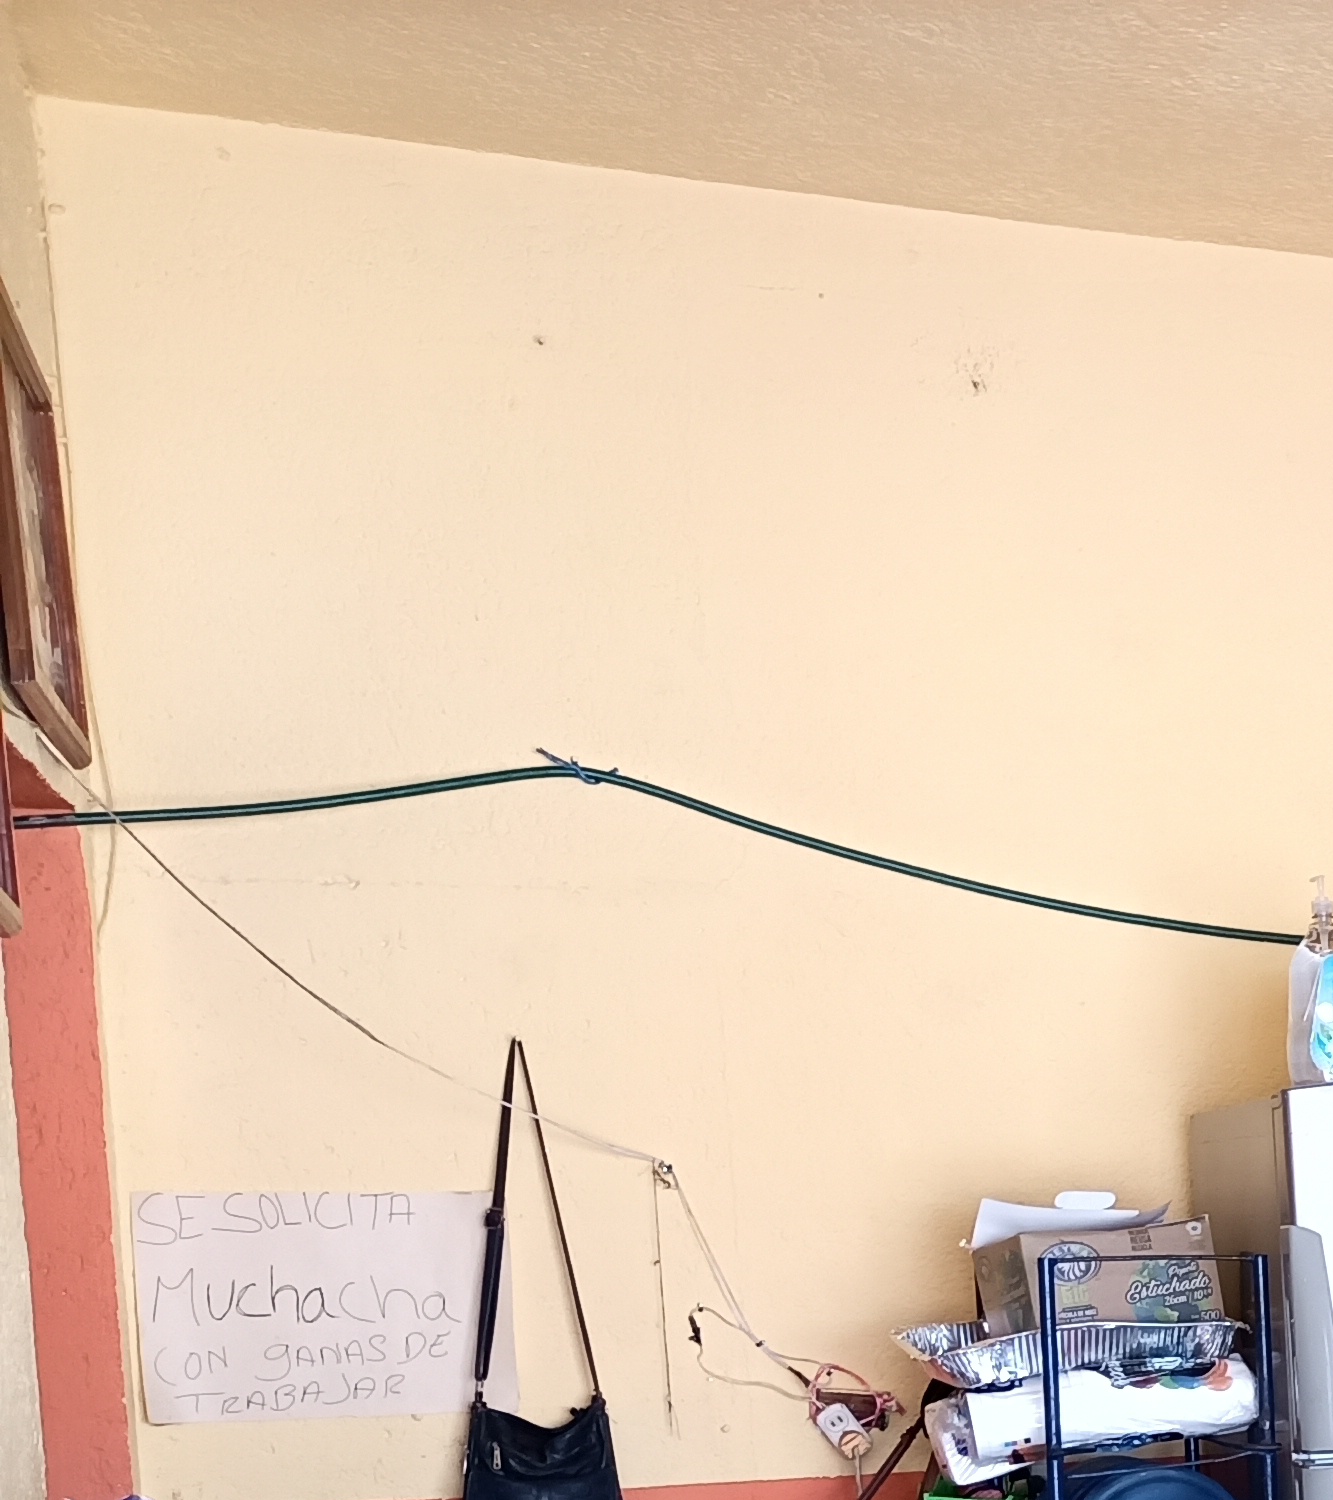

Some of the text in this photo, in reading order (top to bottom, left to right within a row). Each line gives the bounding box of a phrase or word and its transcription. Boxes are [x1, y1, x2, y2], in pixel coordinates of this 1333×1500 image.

[137, 1191, 415, 1245] SE SOLICITA
[152, 1265, 462, 1326] Muchacha
[1126, 1271, 1210, 1304] Estuchado
[1200, 1309, 1220, 1321] 500
[154, 1347, 228, 1387] CON
[397, 1331, 451, 1365] DE
[174, 1373, 406, 1416] TRABAJAR
